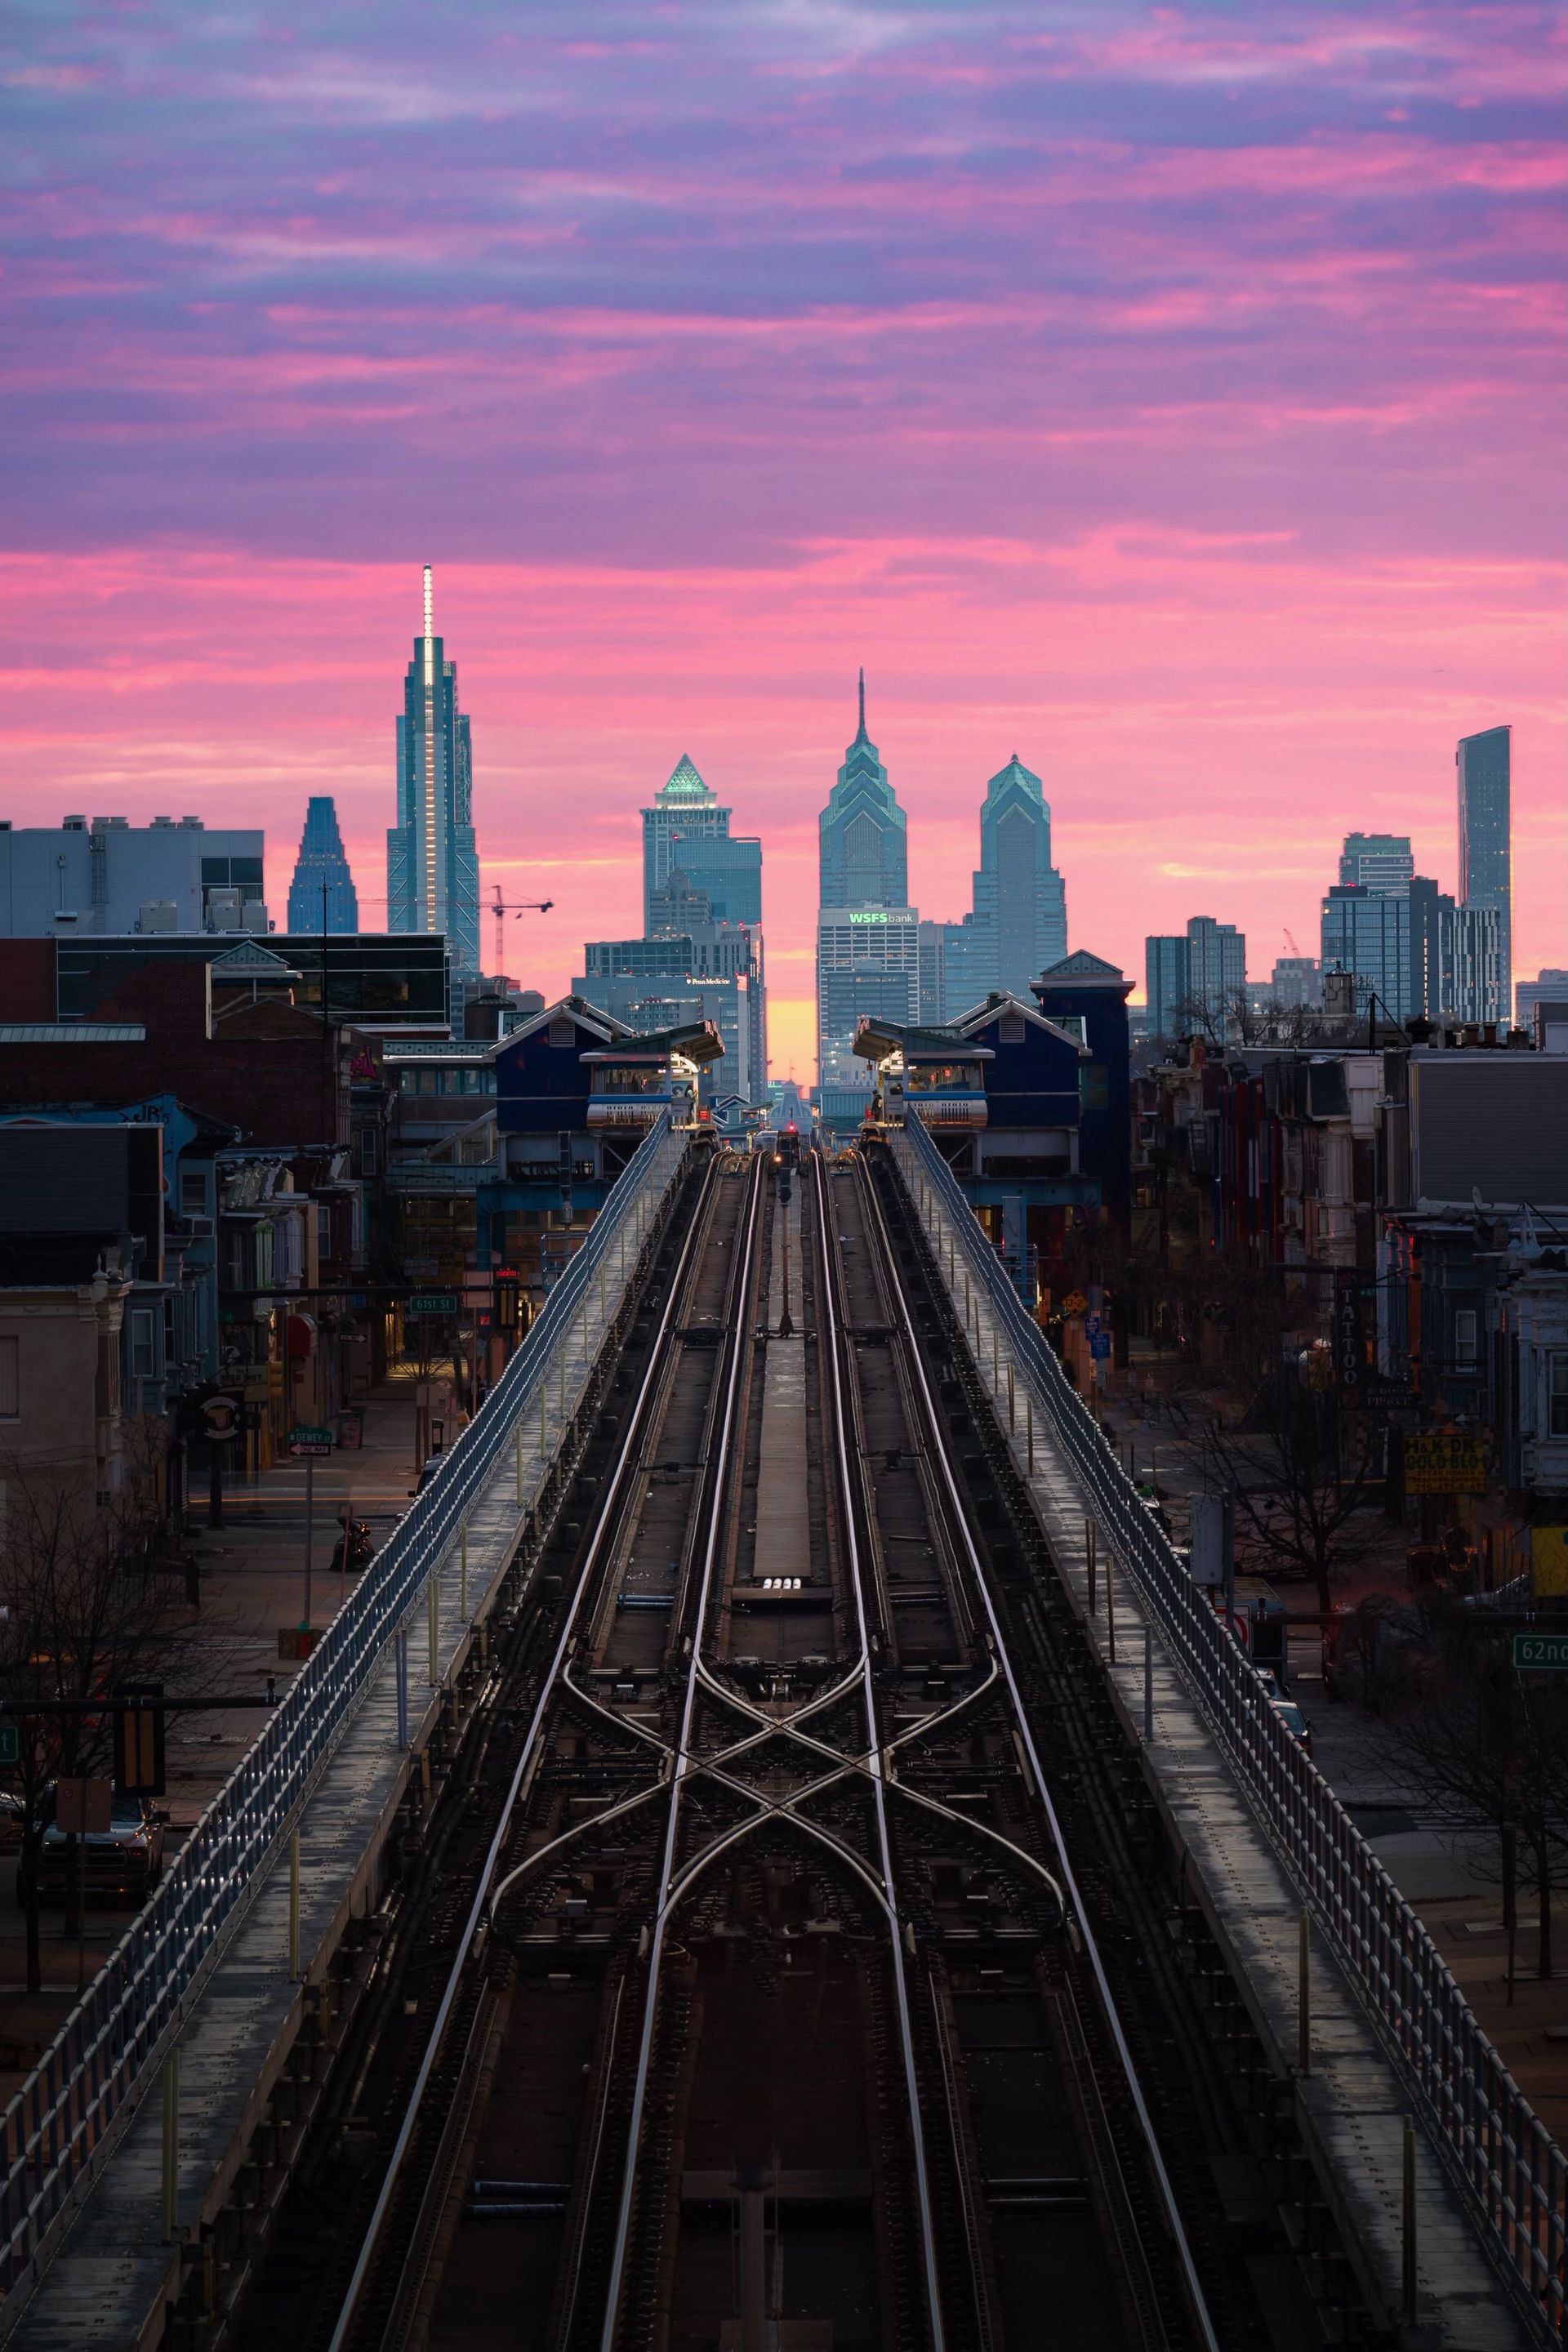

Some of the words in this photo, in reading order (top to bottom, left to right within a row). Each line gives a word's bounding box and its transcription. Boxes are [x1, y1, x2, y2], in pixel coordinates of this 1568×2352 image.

[849, 913, 888, 924] WSFS
[888, 914, 913, 923] bank
[417, 1299, 436, 1309] 61st
[441, 1299, 450, 1309] St
[1341, 1289, 1356, 1384] TATTOO
[296, 1432, 322, 1442] DEWEY
